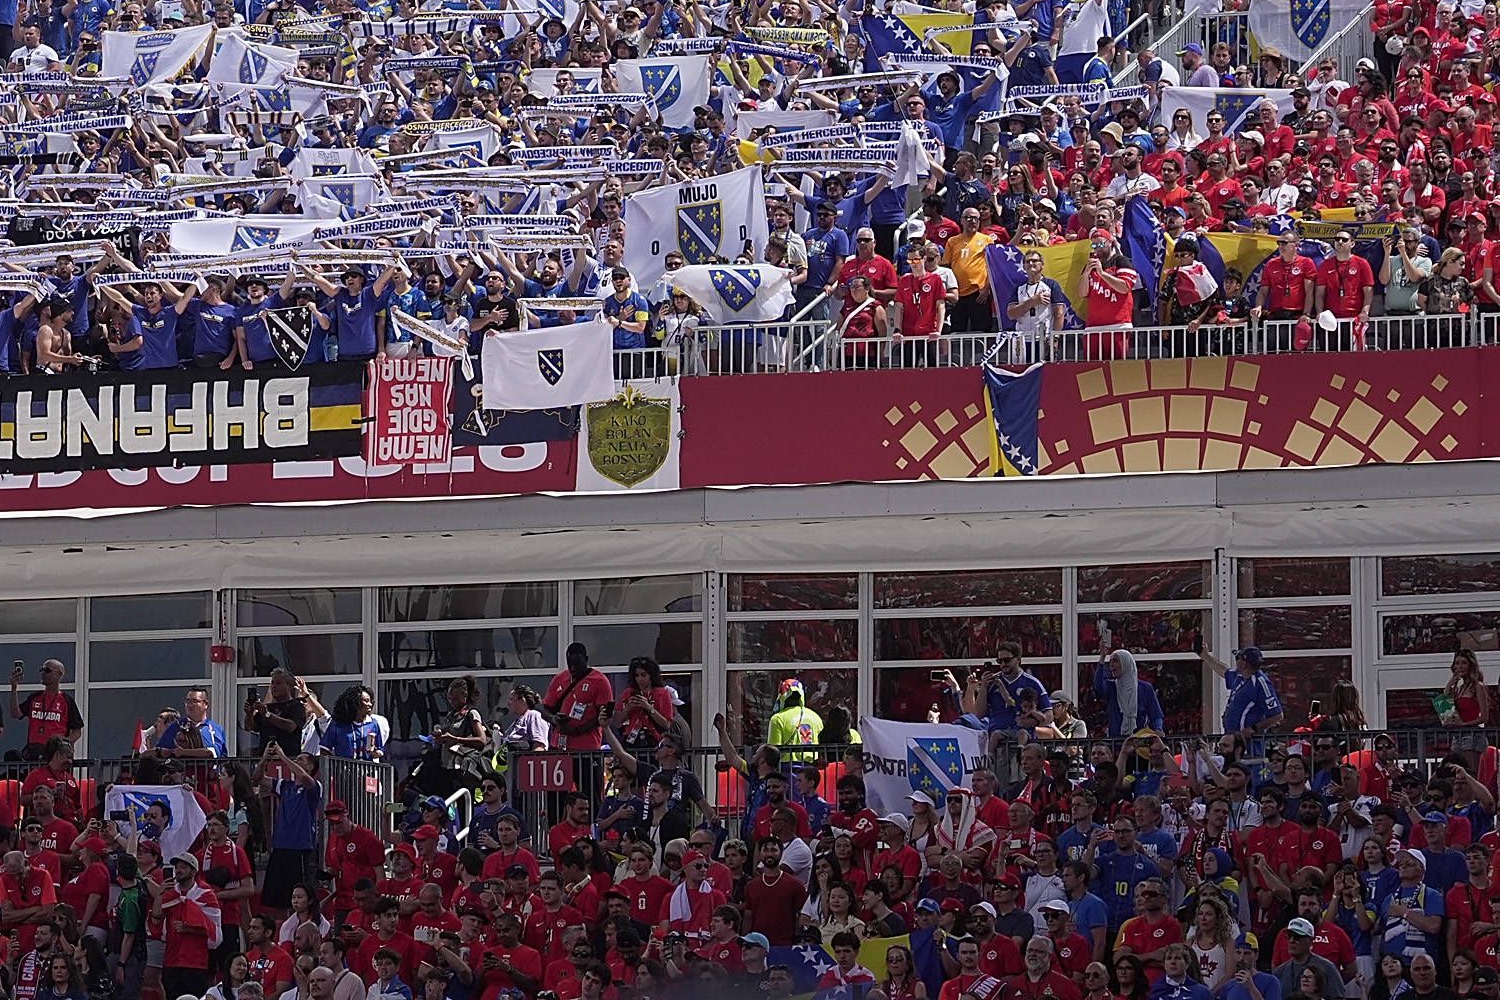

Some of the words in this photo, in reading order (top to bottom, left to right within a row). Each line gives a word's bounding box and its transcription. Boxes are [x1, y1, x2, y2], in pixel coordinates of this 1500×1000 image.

[786, 151, 822, 161] BOSNA
[679, 183, 717, 204] MUJO
[351, 218, 424, 234] HERCEGOVINA
[740, 224, 747, 241] D
[652, 240, 660, 256] O
[129, 272, 198, 283] HERCEGOVINA
[381, 358, 446, 383] NEMA
[391, 384, 432, 408] NAS
[388, 409, 437, 434] GDJE
[612, 415, 647, 428] KAKO
[606, 428, 652, 440] BOLAN
[379, 436, 445, 460] NEMA
[608, 441, 648, 452] NEMA
[31, 710, 61, 722] CANADA
[528, 760, 565, 787] 116
[856, 817, 873, 833] 87
[38, 840, 57, 850] ADA
[1115, 880, 1128, 896] 10
